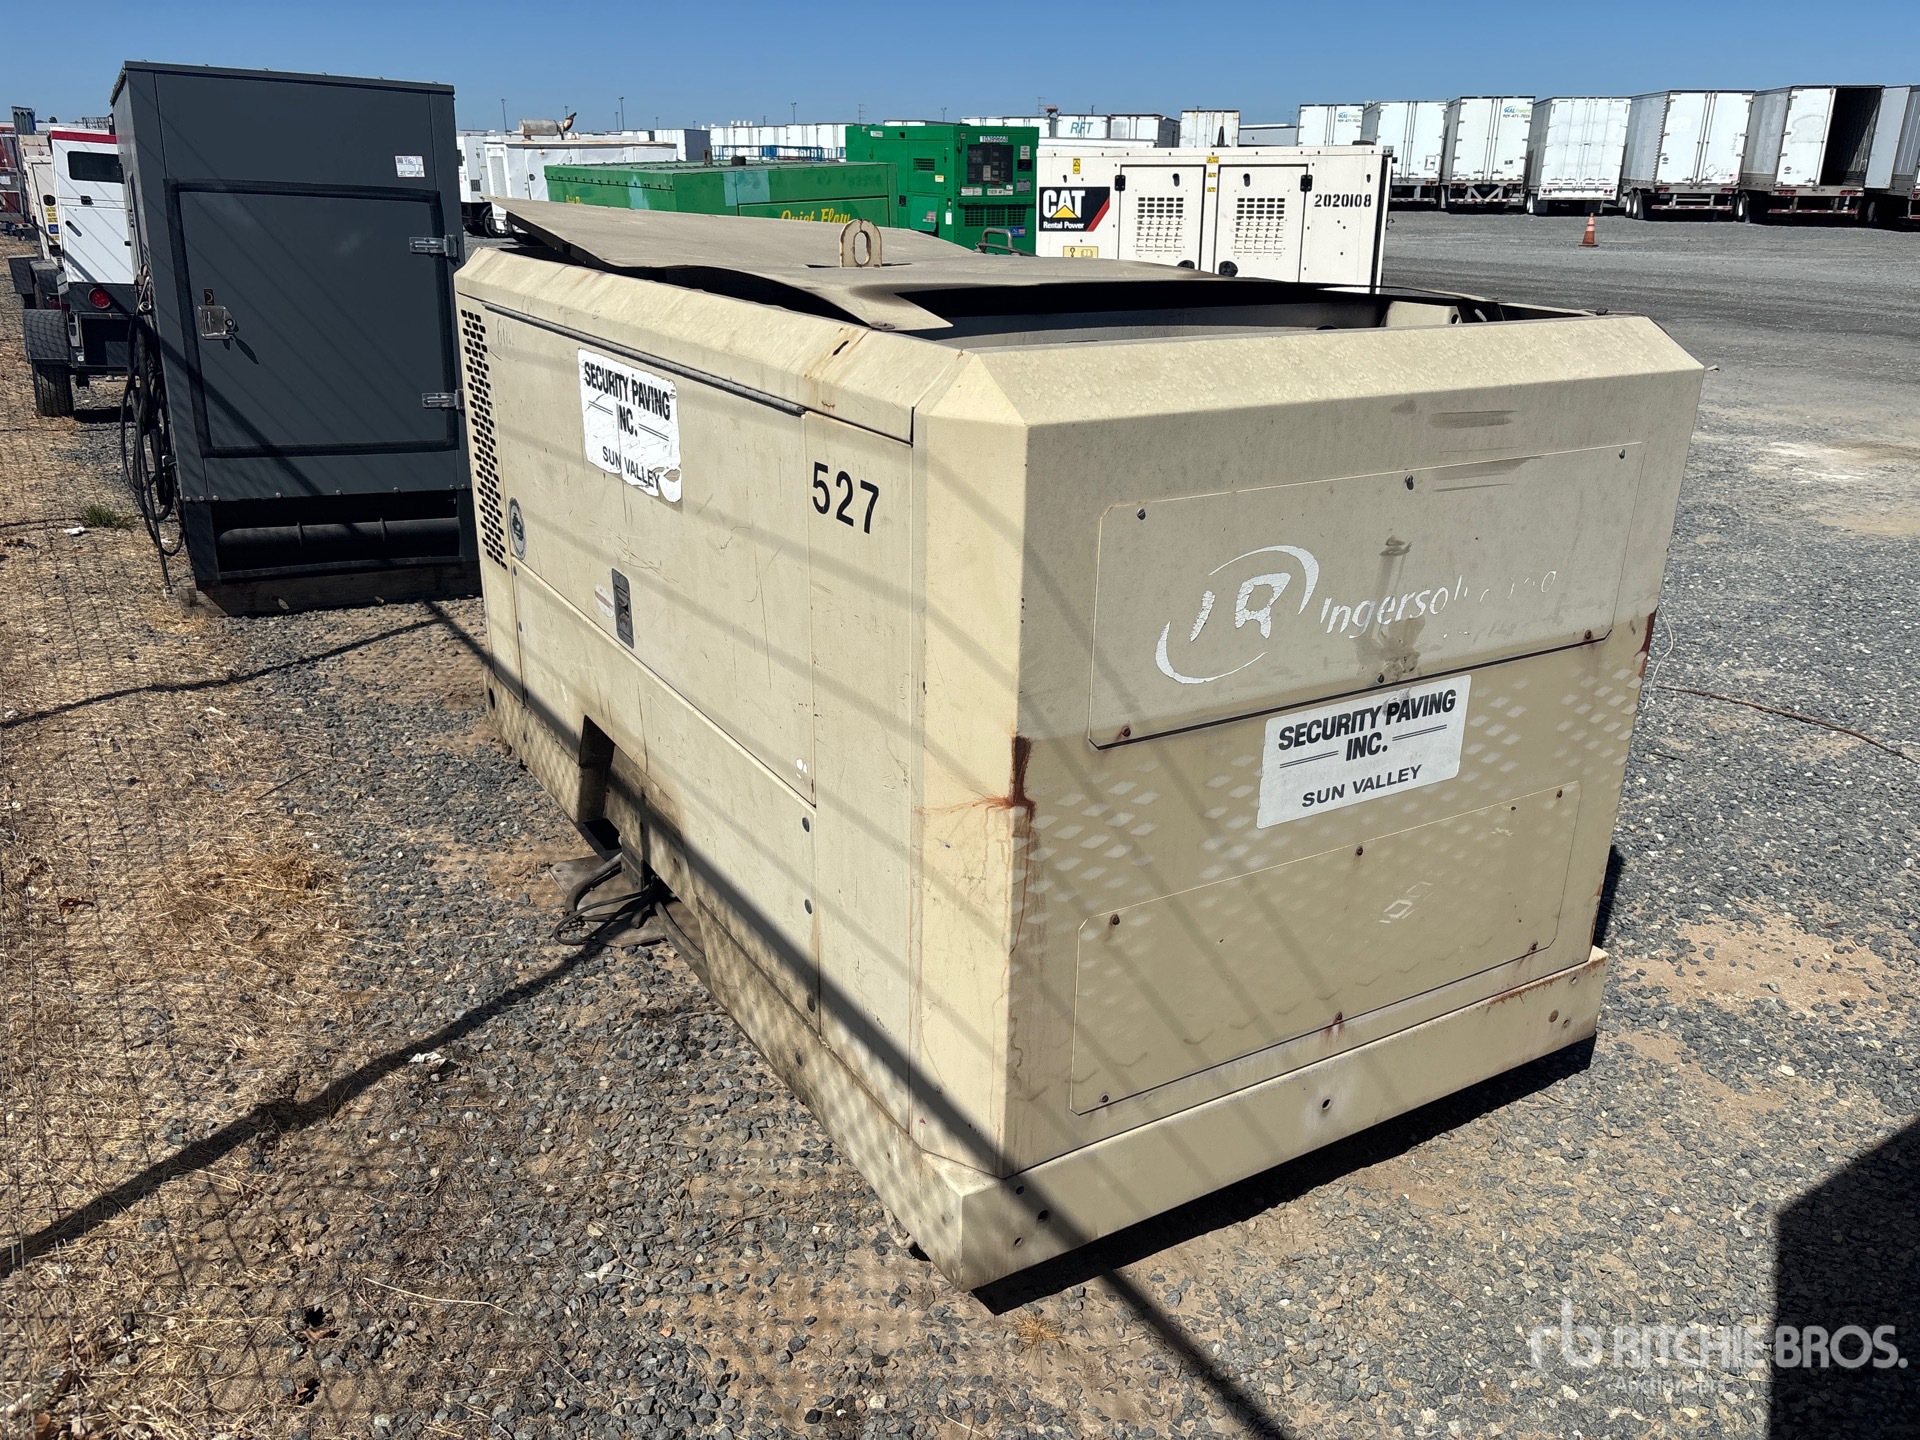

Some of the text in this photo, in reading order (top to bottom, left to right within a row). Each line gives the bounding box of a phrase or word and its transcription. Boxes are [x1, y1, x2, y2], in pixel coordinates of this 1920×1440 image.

[1042, 189, 1086, 219] CAT
[1314, 193, 1371, 207] 2020108
[1043, 221, 1084, 229] Rental Power
[584, 361, 671, 421] SECURITY PAVING
[602, 446, 660, 490] SUN VALLEY
[812, 461, 879, 534] 527
[1278, 689, 1457, 750] SECURITY PAVING
[1346, 731, 1388, 761] INC.
[1302, 764, 1422, 807] SUN VALLEY
